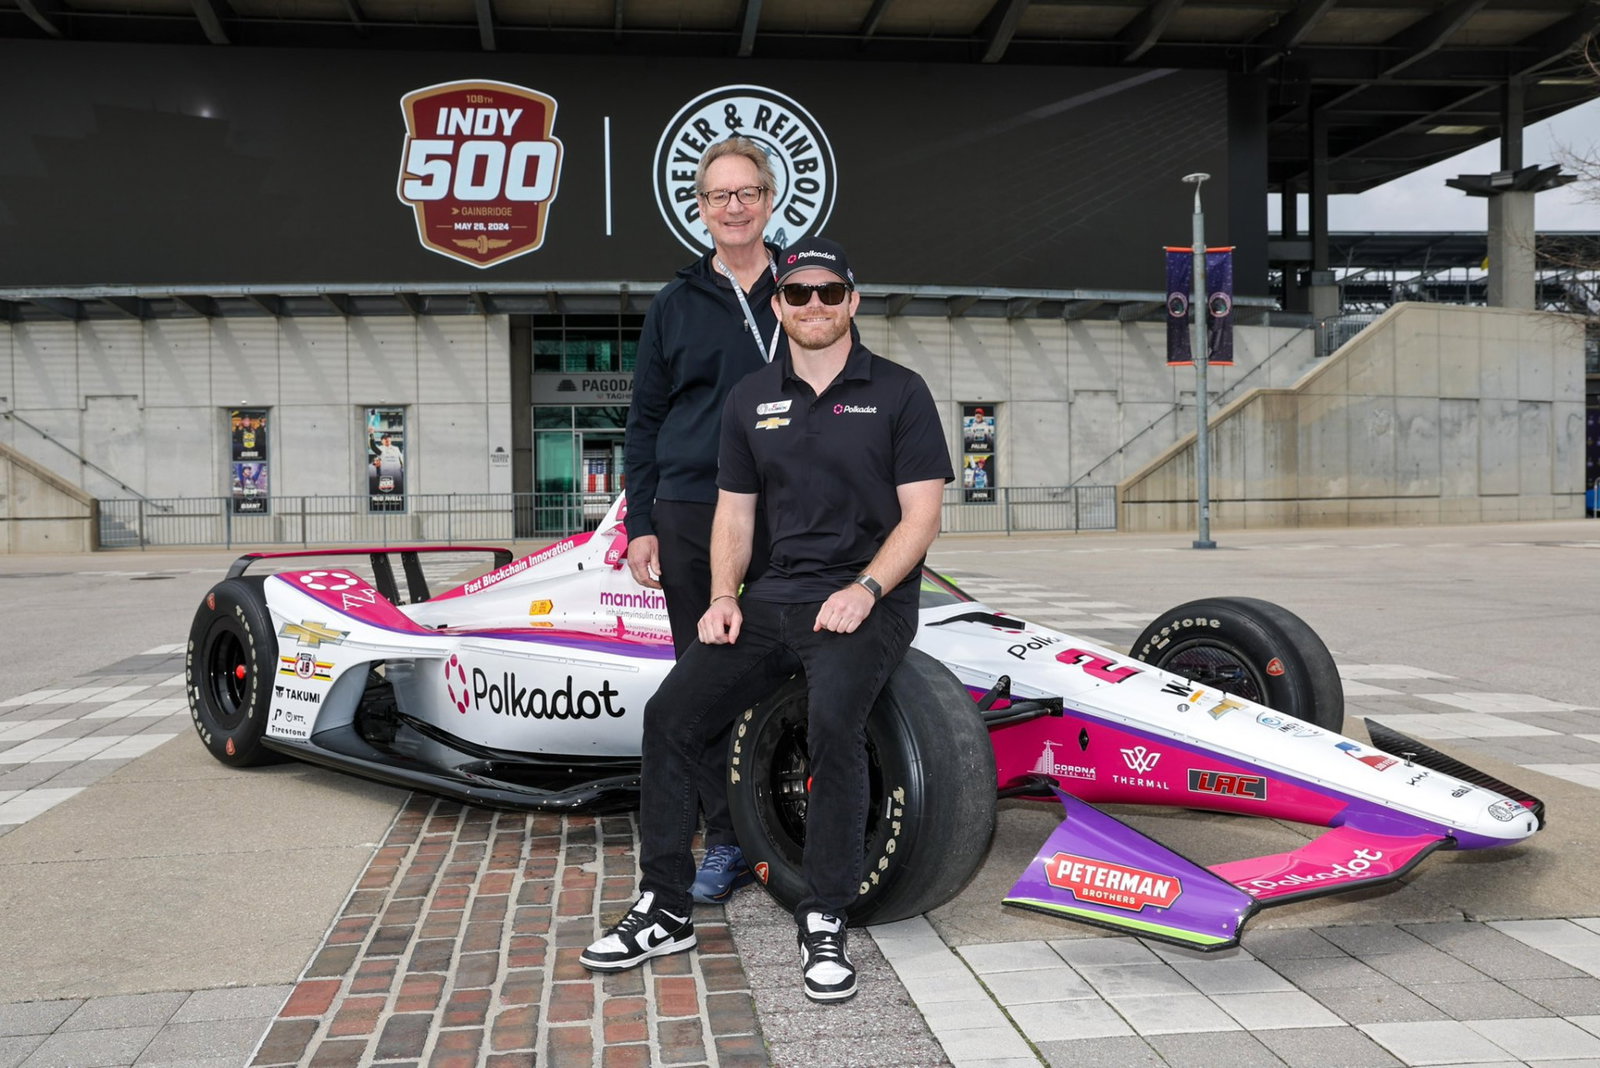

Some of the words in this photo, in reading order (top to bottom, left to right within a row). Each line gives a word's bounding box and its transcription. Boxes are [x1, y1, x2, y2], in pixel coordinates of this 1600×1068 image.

[466, 94, 494, 104] 108TH
[436, 107, 523, 136] INDY
[403, 139, 558, 202] 500
[671, 117, 719, 225] DREYER
[723, 103, 745, 130] &
[753, 103, 821, 227] REINBOLD
[461, 207, 513, 217] GAINBRIDGE
[454, 222, 471, 231] MAY
[487, 222, 510, 231] 2024
[798, 250, 837, 262] Polkadot
[843, 404, 878, 414] Polkadot
[464, 577, 482, 595] Fast
[483, 562, 528, 587] Blockchain
[529, 540, 574, 567] Innovation
[600, 590, 667, 609] mannkin
[606, 608, 670, 621] inhalemyinsulin.com
[286, 688, 320, 703] TAKUMI
[472, 667, 626, 720] Polkadot
[271, 725, 306, 737] Firestone
[1054, 763, 1096, 774] CORONA
[1112, 775, 1170, 790] THERMAL
[1197, 772, 1259, 797] LAC
[1250, 848, 1383, 890] Polkadot
[1056, 860, 1172, 899] PETERMAN
[1082, 888, 1136, 906] BROTHERS
